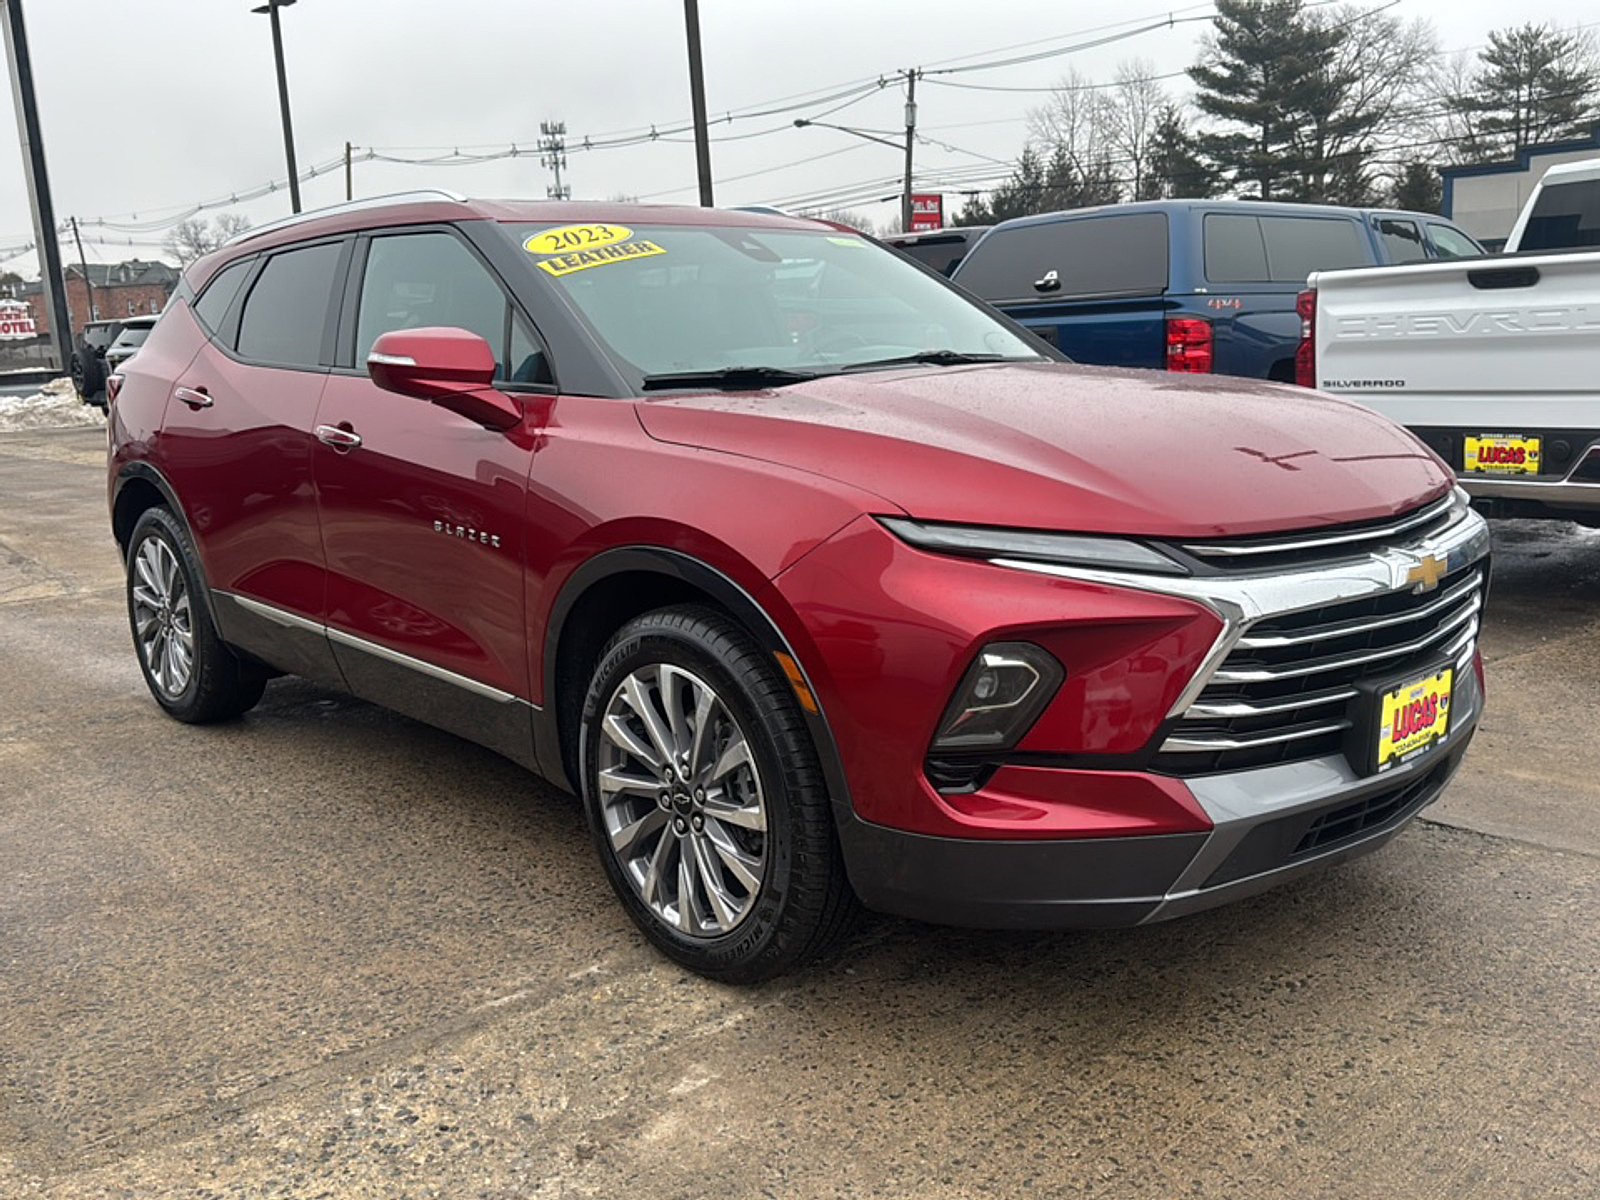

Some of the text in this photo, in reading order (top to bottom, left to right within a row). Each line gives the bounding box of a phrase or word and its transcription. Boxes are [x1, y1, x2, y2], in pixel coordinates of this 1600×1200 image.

[545, 225, 614, 251] 2023
[548, 241, 656, 272] LEATHER
[0, 321, 36, 334] OTEL
[1322, 379, 1406, 389] SILVERADO
[1477, 446, 1526, 465] LUCAS
[434, 520, 501, 548] BLAZER
[1391, 691, 1438, 744] LUCAS
